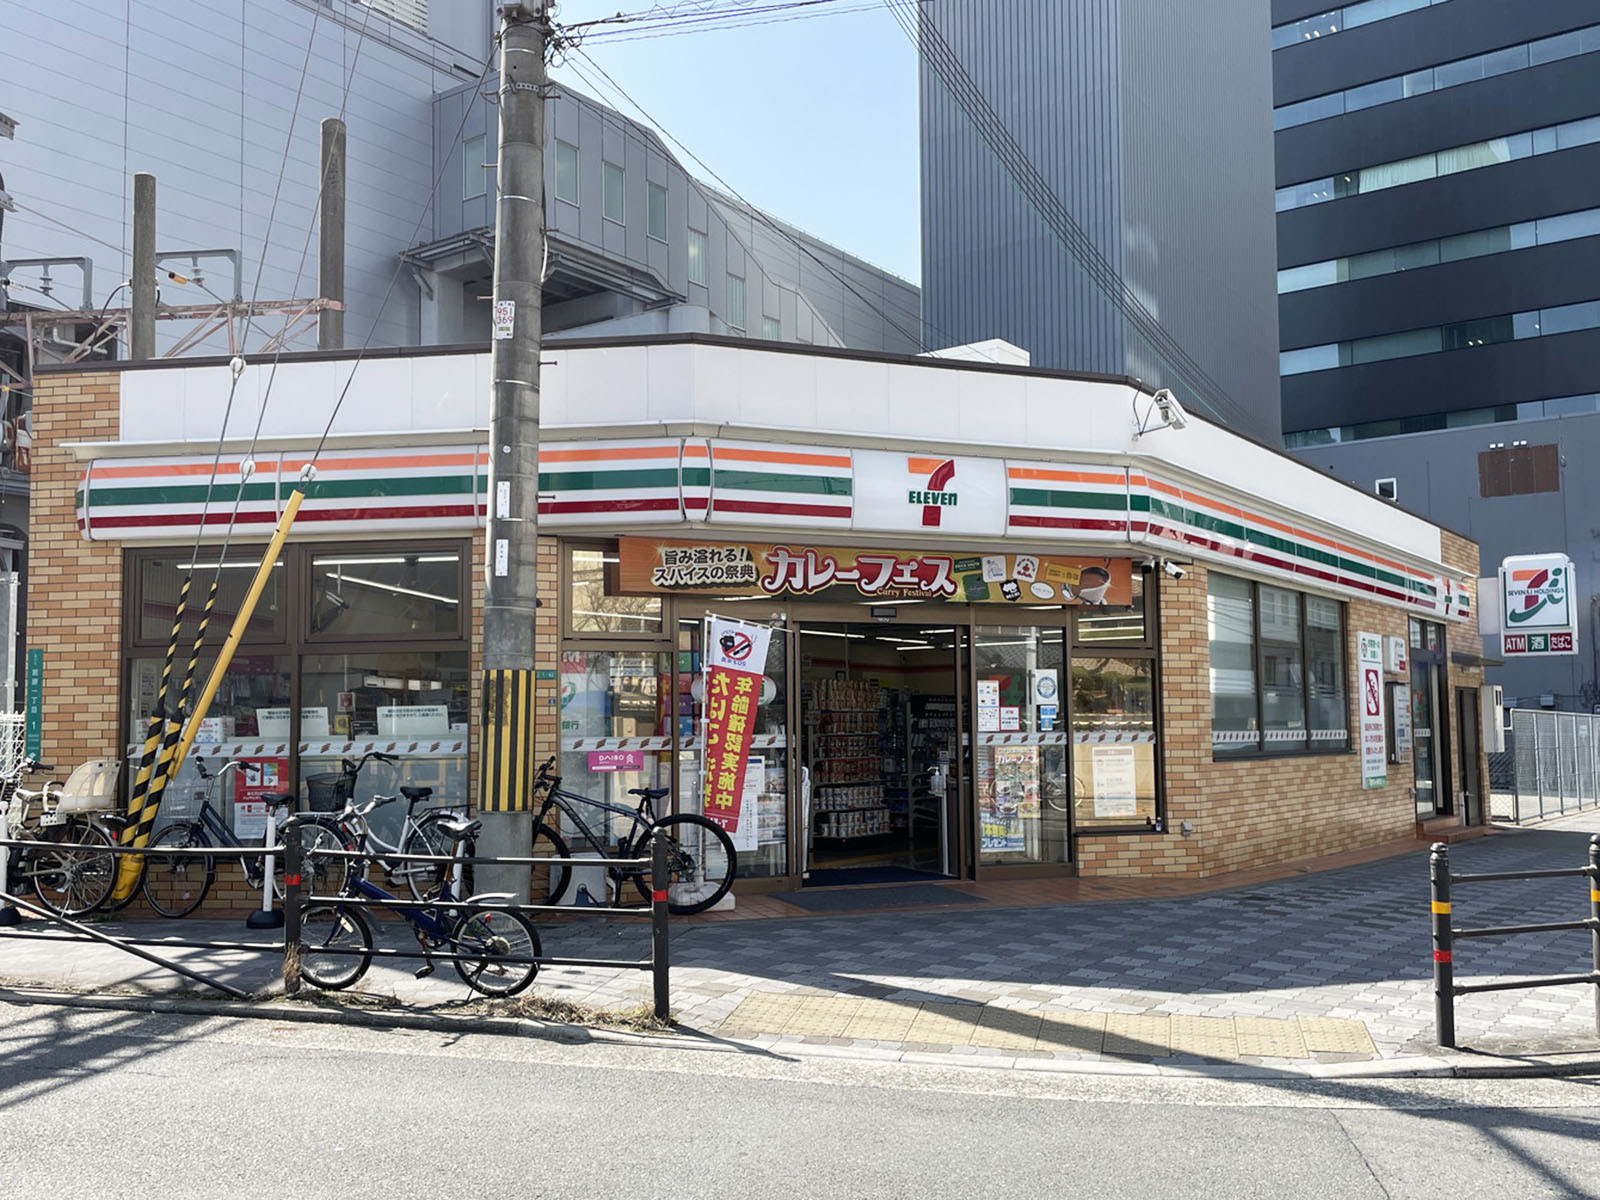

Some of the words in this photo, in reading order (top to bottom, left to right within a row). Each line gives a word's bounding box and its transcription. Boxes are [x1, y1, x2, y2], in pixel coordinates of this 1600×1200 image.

[496, 315, 513, 324] 369
[654, 563, 755, 583] スパイスの祭典
[763, 548, 957, 594] カレーフェス
[876, 587, 901, 598] Curry
[903, 588, 933, 598] Festival
[1505, 637, 1525, 650] ATM
[1531, 636, 1545, 650] 酒
[1550, 634, 1572, 649] たばこ
[598, 754, 625, 762] DAISO
